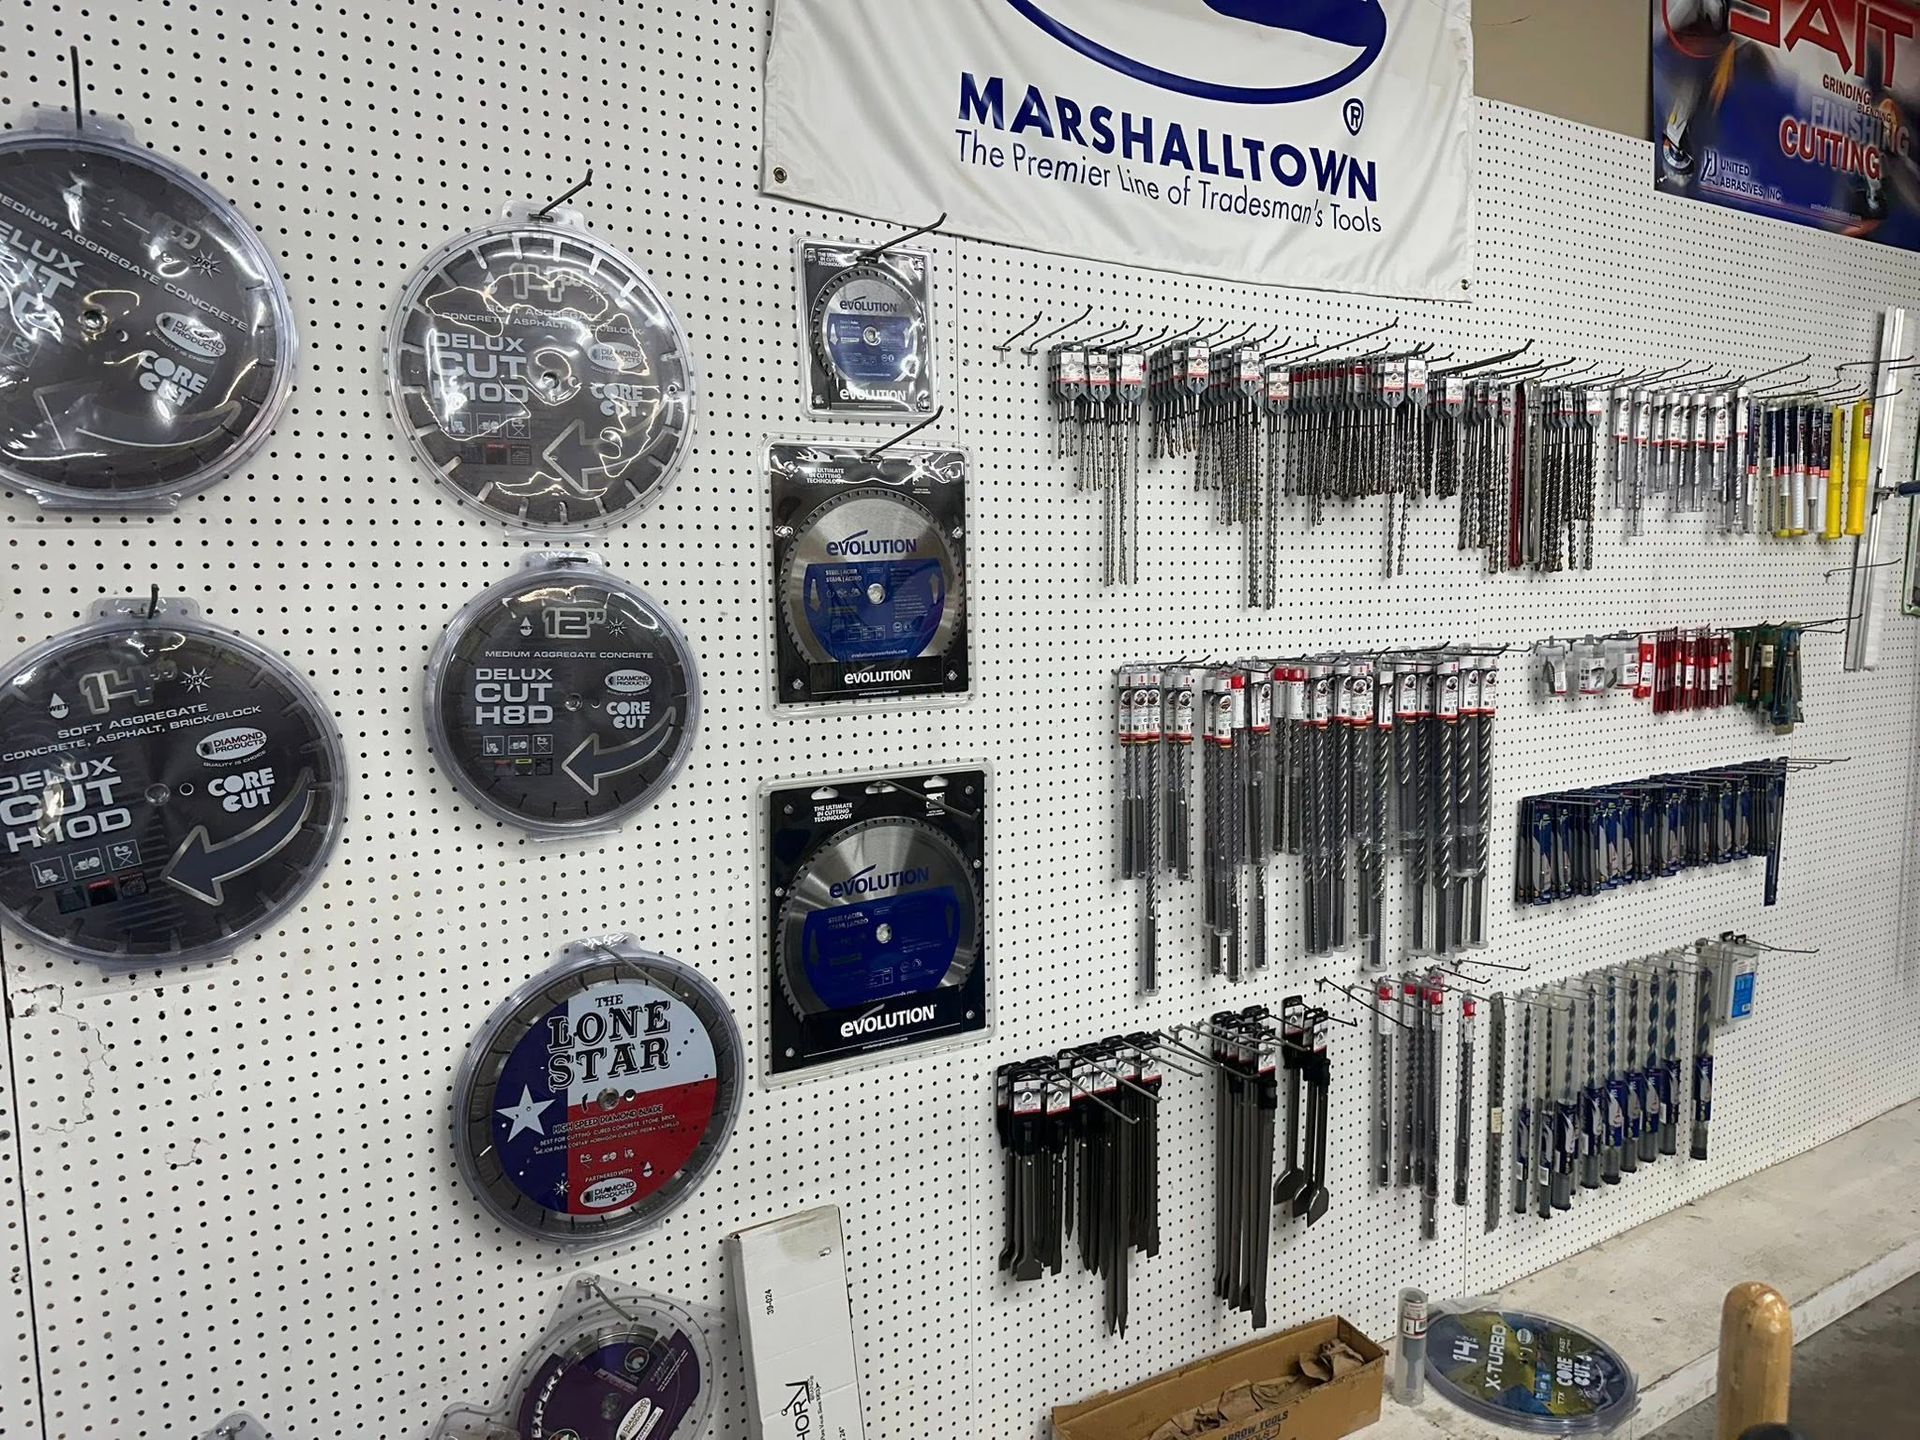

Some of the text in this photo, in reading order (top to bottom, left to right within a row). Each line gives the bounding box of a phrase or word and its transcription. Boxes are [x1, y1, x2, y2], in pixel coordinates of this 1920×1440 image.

[1822, 73, 1871, 105] GRINDING
[1810, 95, 1910, 155] FINISHING
[1857, 104, 1892, 123] BLENDING
[958, 71, 1377, 202] MARSHALLTOWN
[1779, 117, 1880, 181] CUTTING
[955, 128, 1382, 233] The Premier Line of Tradesman's Tools
[1720, 159, 1750, 176] UNITED
[0, 220, 85, 278] ELUX
[61, 228, 161, 284] AGGREGATE
[164, 282, 248, 332] CONCRETE
[172, 326, 221, 356] PRODUCTS
[433, 332, 524, 352] DELUX
[139, 350, 208, 394] CORE
[430, 352, 528, 379] CUT
[590, 383, 643, 400] CORE
[533, 651, 597, 659] AGGREGATE
[599, 651, 654, 659] CONCRETE
[475, 668, 553, 680] DELUX
[475, 683, 553, 703] CUT
[57, 703, 209, 739] SOFT AGGREGATE
[475, 705, 553, 725] H8D
[606, 701, 650, 715] CORE
[1, 705, 263, 762] CONCRETE, ASPHALT, BRICK/BLOCK
[613, 715, 646, 729] CUT
[213, 730, 264, 748] DIAMOND
[214, 738, 265, 754] PRODUCTS
[0, 756, 117, 795] DELUX
[207, 767, 275, 797] CORE
[0, 776, 122, 827] CUT
[222, 787, 272, 813] CUT
[823, 807, 850, 816] CUTTING
[825, 802, 853, 810] ULTIMATE
[5, 807, 132, 853] H10D
[814, 813, 852, 823] TECHNOLOGY
[595, 994, 623, 1008] THE
[548, 1001, 671, 1053] LONE
[548, 1037, 671, 1093] STAR
[552, 1103, 664, 1135] HIGH SPEED DIAMOND BLADE
[585, 1167, 633, 1183] PARTNERED WITH
[594, 1181, 635, 1195] DIAMOND
[594, 1188, 634, 1202] PRODUCTS
[764, 1289, 774, 1315] 39-024
[1556, 1356, 1573, 1387] CORE
[1574, 1362, 1592, 1386] CUT
[622, 1399, 647, 1432] DIAMOND
[627, 1401, 650, 1434] PRODUCTS
